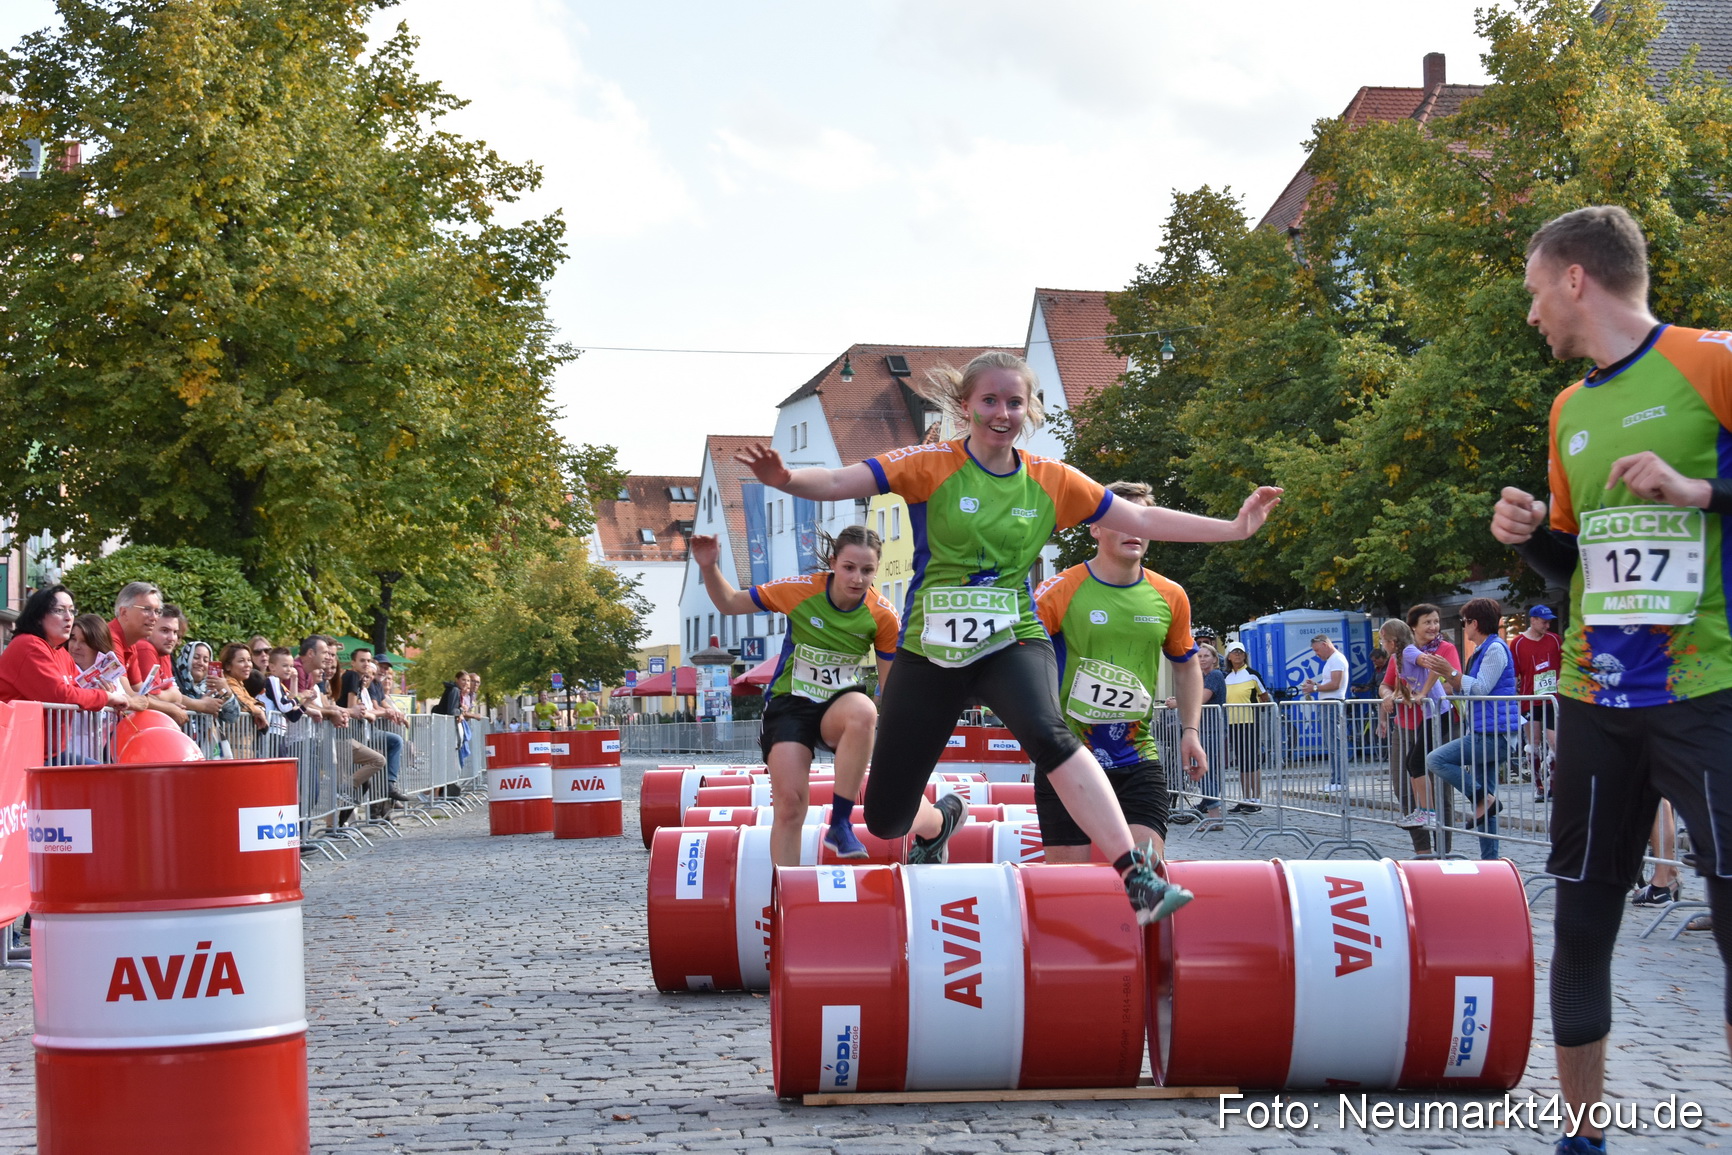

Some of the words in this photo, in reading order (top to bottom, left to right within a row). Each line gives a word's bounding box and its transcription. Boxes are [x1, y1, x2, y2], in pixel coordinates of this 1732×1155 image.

[1622, 405, 1666, 427] BOCK
[1586, 511, 1692, 539] BOCK
[885, 560, 901, 576] HOTEL
[1605, 548, 1670, 583] 127
[931, 591, 1009, 611] BOCK
[1603, 594, 1670, 610] MARTIN
[945, 617, 995, 642] 121
[800, 646, 858, 665] BOCK
[1090, 684, 1134, 709] 122
[1085, 708, 1125, 719] JONAS
[500, 775, 532, 790] AVIA
[571, 776, 605, 791] AVIA
[44, 843, 72, 852] energie
[1324, 876, 1382, 977] AVIA
[931, 896, 982, 1009] AVIA
[106, 941, 244, 1002] AVIA
[851, 1025, 859, 1060] energie
